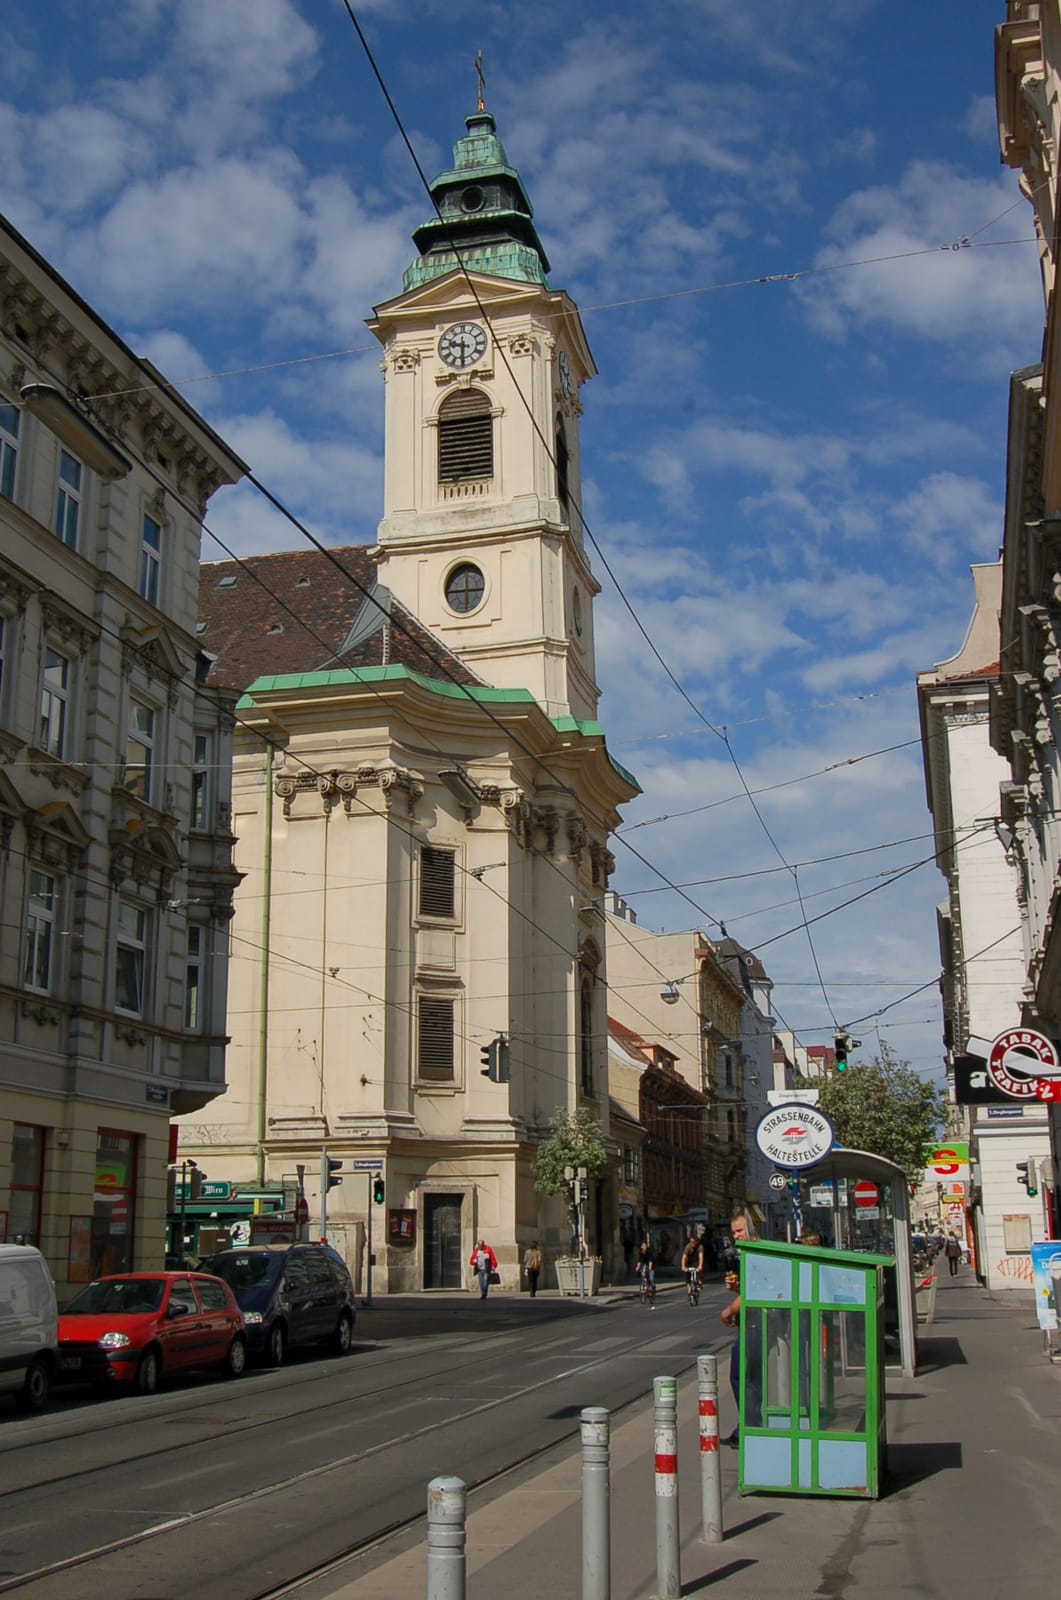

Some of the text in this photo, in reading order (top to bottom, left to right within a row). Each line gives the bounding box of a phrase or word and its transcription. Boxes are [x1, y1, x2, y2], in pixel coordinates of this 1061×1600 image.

[1000, 1034, 1051, 1058] TABAK
[992, 1059, 1038, 1093] TRAFIK
[763, 1111, 825, 1134] STRASSENBAHN
[766, 1143, 823, 1162] HALTESTELLE
[934, 1149, 960, 1175] S
[771, 1176, 784, 1186] 49
